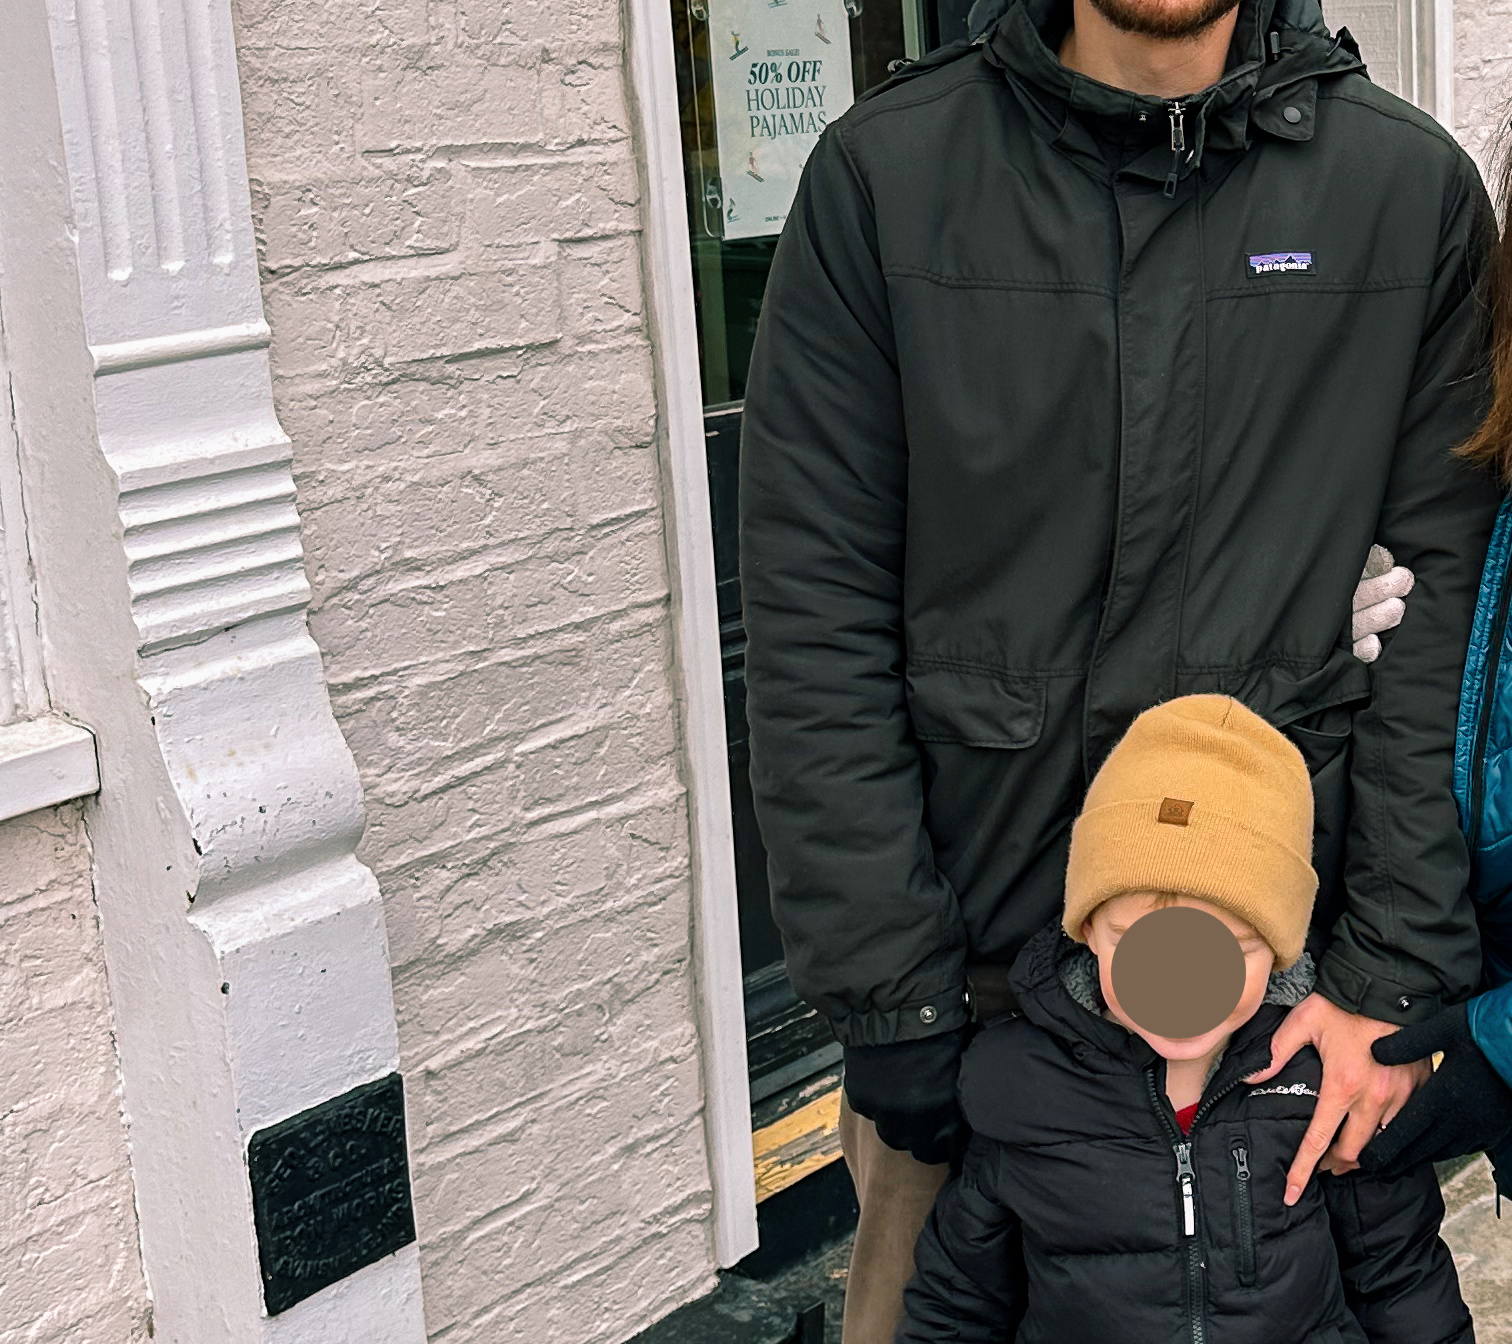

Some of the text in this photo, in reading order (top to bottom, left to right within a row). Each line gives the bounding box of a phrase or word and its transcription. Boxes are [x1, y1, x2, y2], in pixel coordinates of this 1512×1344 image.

[747, 59, 823, 85] 50% OFF
[745, 85, 827, 111] HOLIDAY
[749, 110, 827, 140] PAJAMAS
[1256, 261, 1308, 274] patagonia
